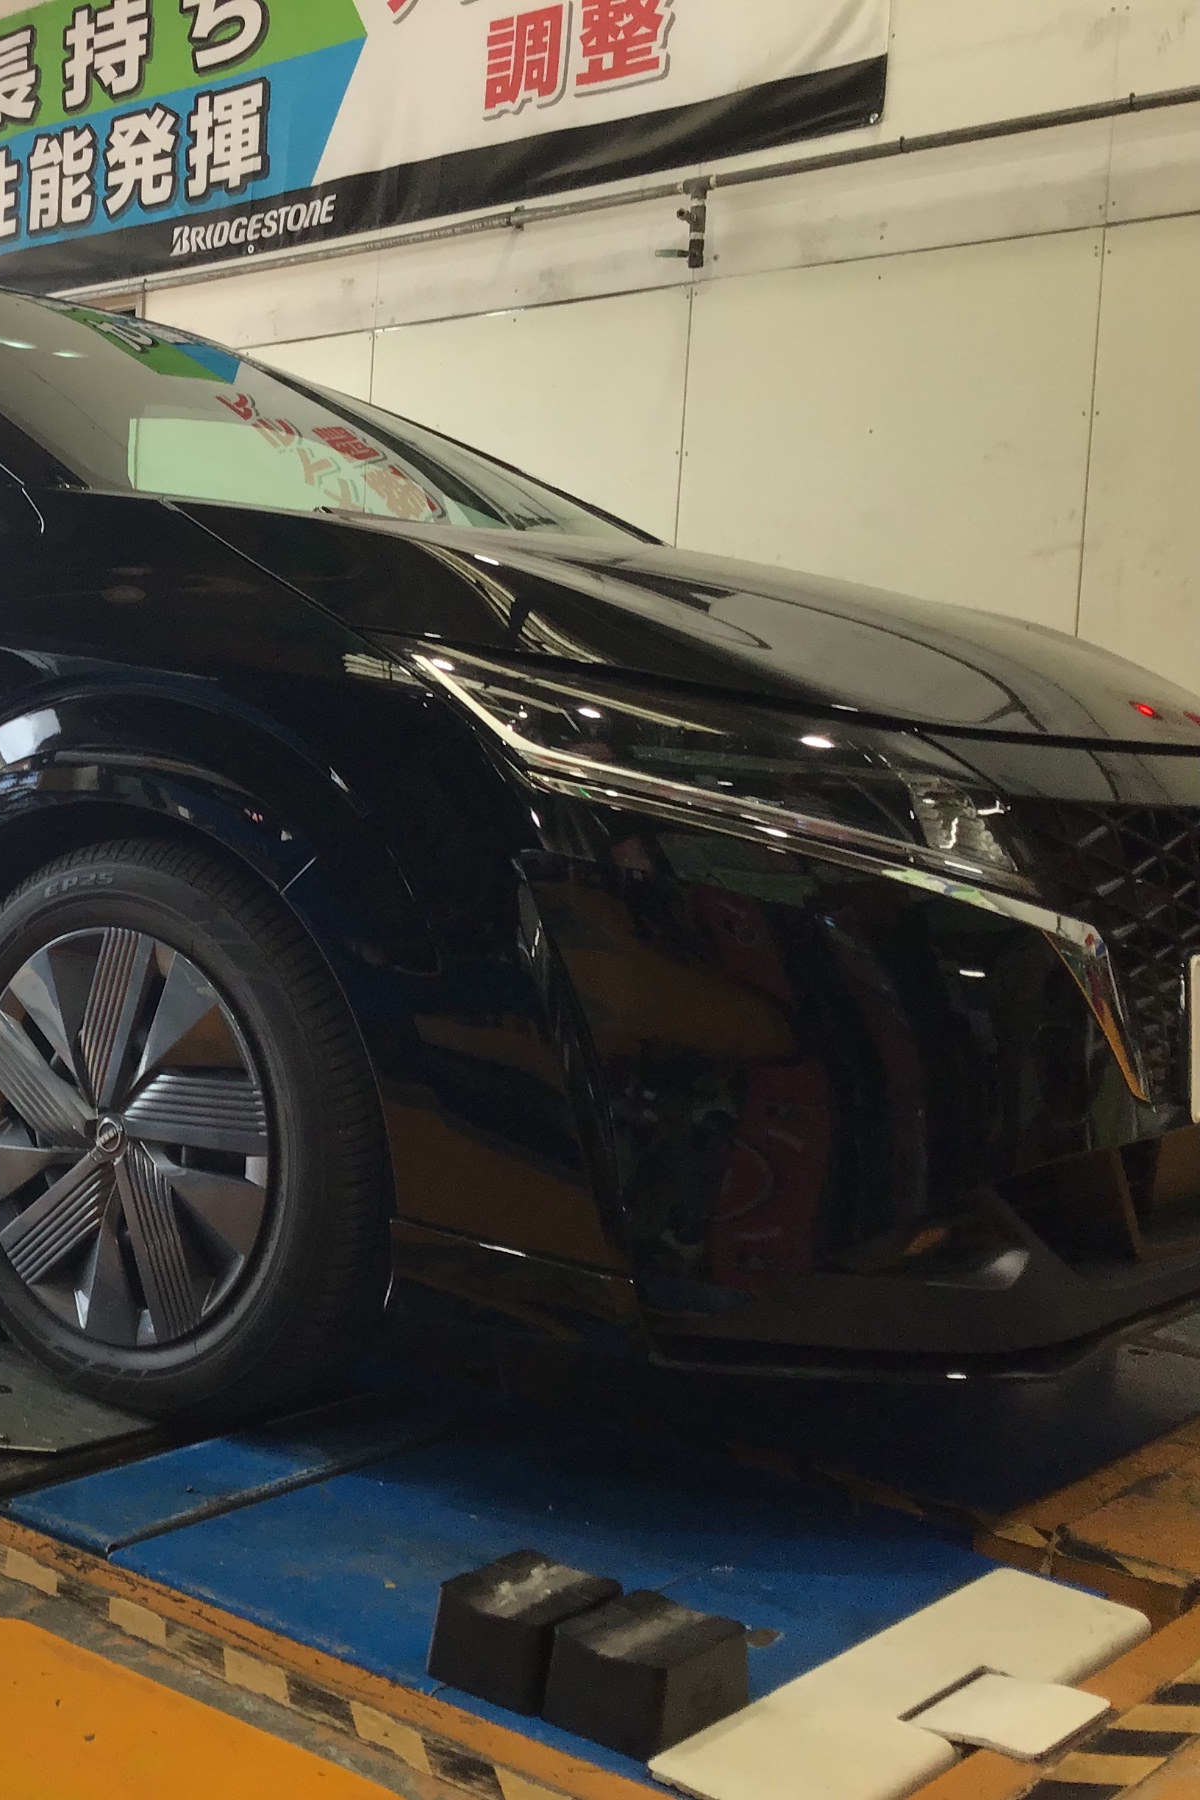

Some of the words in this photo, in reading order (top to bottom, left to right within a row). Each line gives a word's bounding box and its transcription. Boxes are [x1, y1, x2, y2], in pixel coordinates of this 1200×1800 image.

[484, 0, 665, 111] 調整
[169, 193, 337, 258] BRIDGESTONE
[43, 872, 114, 898] EP25
